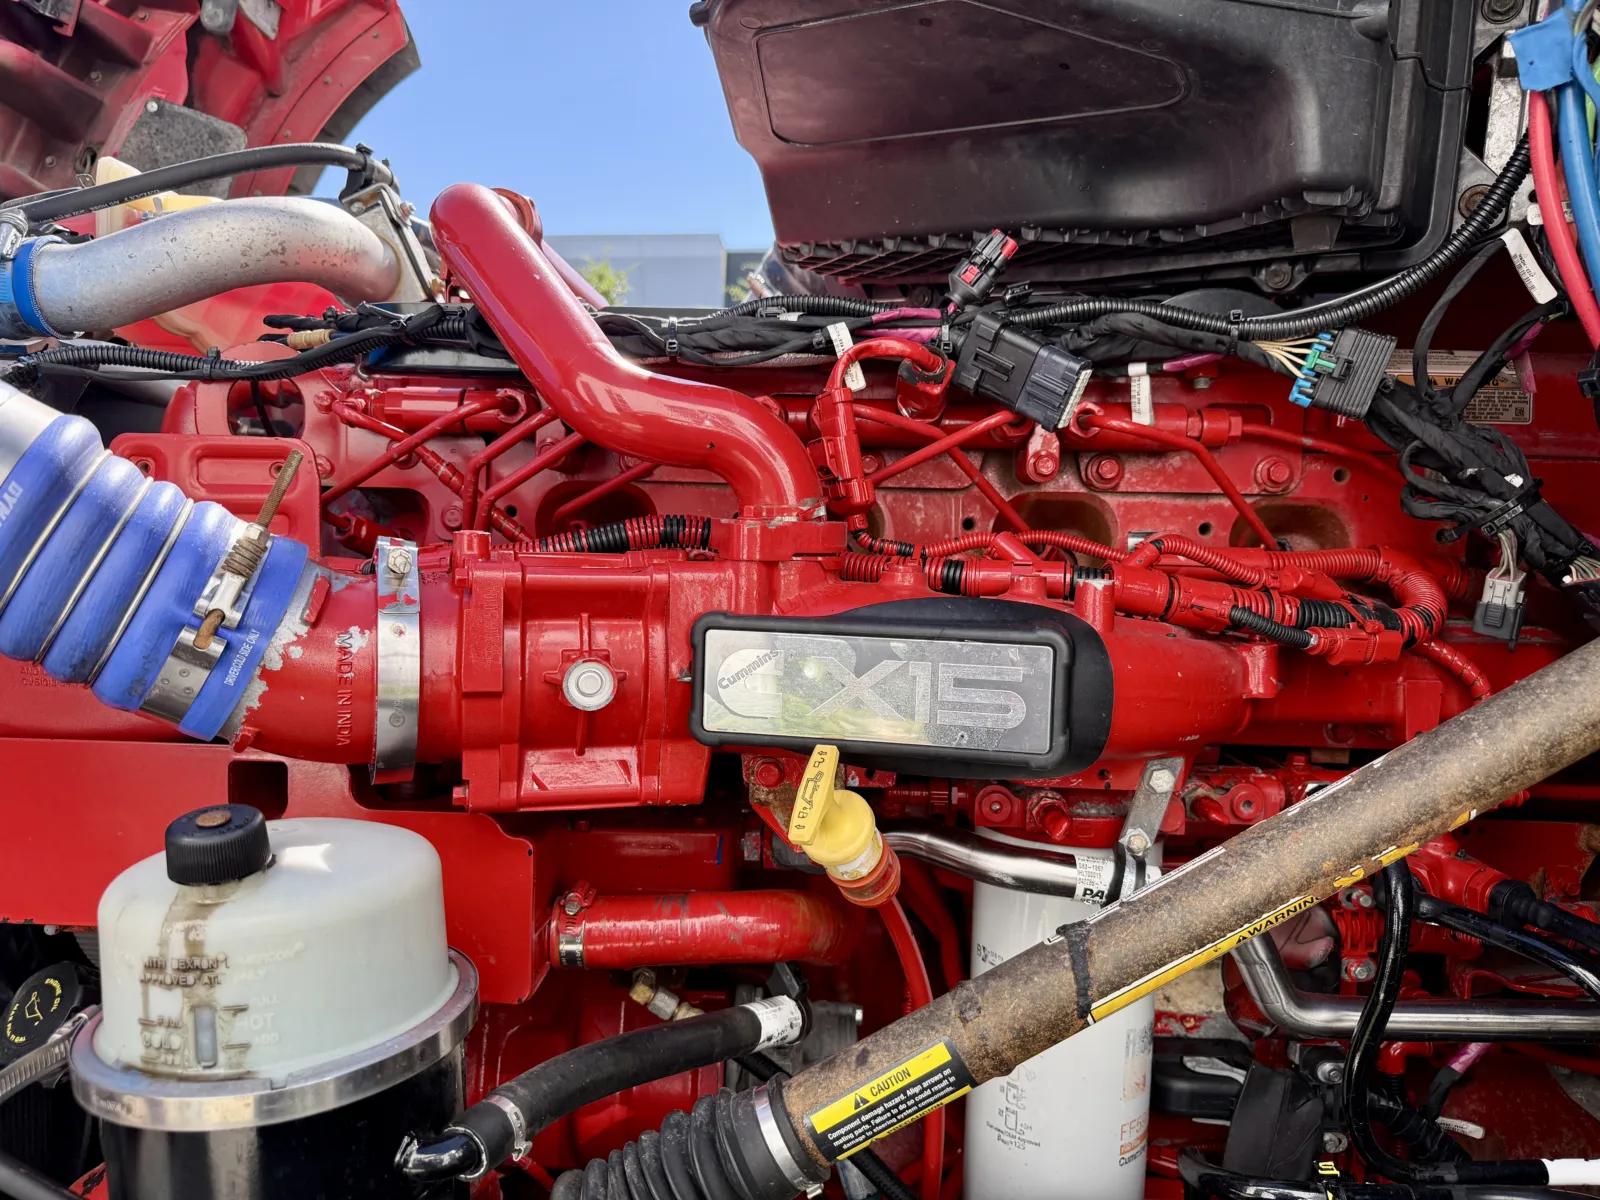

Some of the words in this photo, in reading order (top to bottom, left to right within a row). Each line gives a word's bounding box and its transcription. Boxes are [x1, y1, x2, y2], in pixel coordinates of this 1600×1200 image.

[239, 641, 253, 657] SIDE
[335, 632, 353, 685] MADE
[717, 647, 779, 690] Cummins
[336, 689, 353, 705] IN
[805, 657, 1027, 729] X15
[336, 710, 353, 746] INDIA
[1247, 897, 1320, 936] WARNIN
[51, 998, 60, 1012] OIL
[869, 1067, 912, 1097] CAUTION
[828, 1118, 862, 1141] Component
[861, 1104, 885, 1123] damage
[884, 1092, 907, 1109] hazard.
[906, 1083, 922, 1098] Align
[922, 1073, 943, 1088] arrows
[943, 1068, 952, 1077] on
[833, 1129, 855, 1148] mating
[854, 1122, 872, 1137] parts.
[871, 1109, 892, 1126] Failure
[891, 1106, 899, 1115] to
[899, 1101, 907, 1111] do
[906, 1098, 915, 1107] so
[915, 1089, 932, 1102] could
[931, 1080, 949, 1095] result
[948, 1075, 956, 1084] in
[843, 1134, 866, 1150] damage
[873, 1117, 897, 1133] steering
[897, 1105, 919, 1120] system
[918, 1086, 956, 1108] components.
